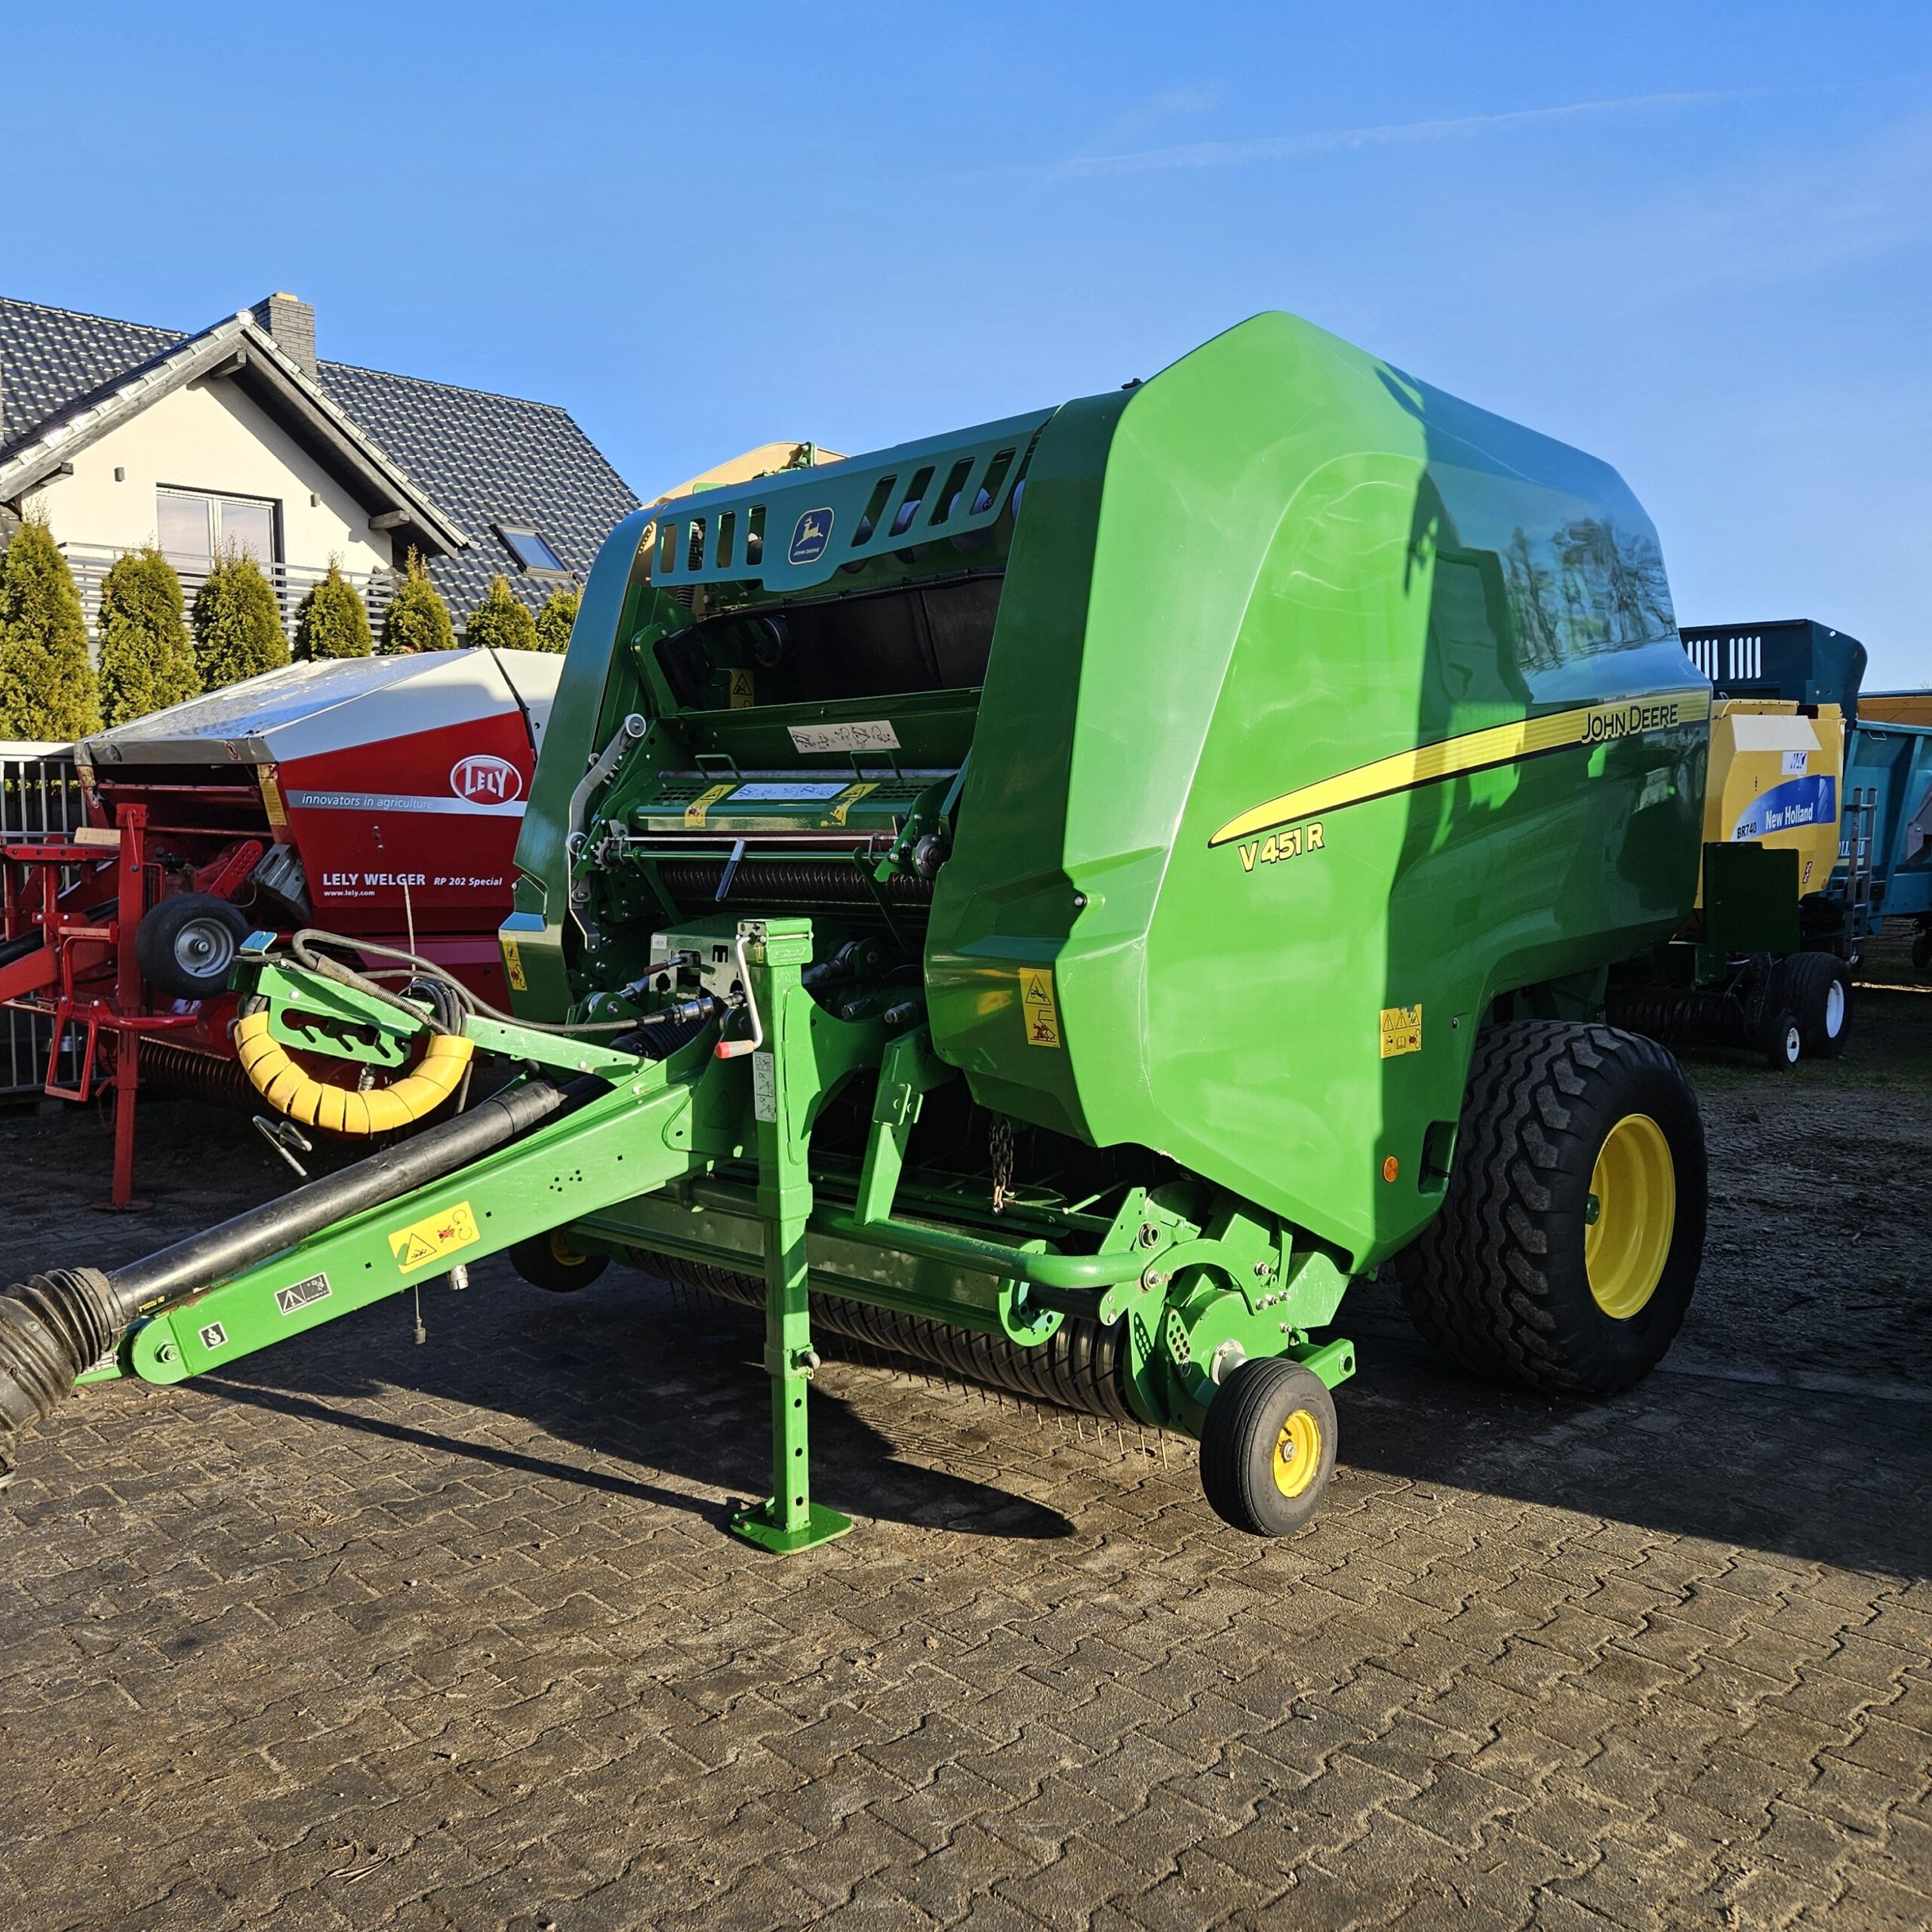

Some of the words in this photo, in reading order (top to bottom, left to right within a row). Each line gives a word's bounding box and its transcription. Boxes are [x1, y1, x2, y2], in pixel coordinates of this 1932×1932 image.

[1581, 712, 1626, 740] JOHN
[1629, 703, 1678, 731] DEERE
[464, 764, 508, 798] LELY
[301, 792, 361, 808] innovators
[364, 795, 374, 808] in
[377, 796, 434, 810] agriculture
[1765, 811, 1783, 830] New
[1784, 802, 1814, 826] Holland
[1737, 821, 1758, 839] BR740
[1238, 840, 1260, 873] V
[1260, 827, 1302, 864] 451
[1306, 821, 1326, 853] R
[322, 872, 359, 887] LELY
[364, 872, 426, 887] WELGER
[433, 877, 448, 887] RP
[448, 877, 466, 887] 202
[468, 876, 503, 888] Special
[323, 889, 376, 898] www.lely.com
